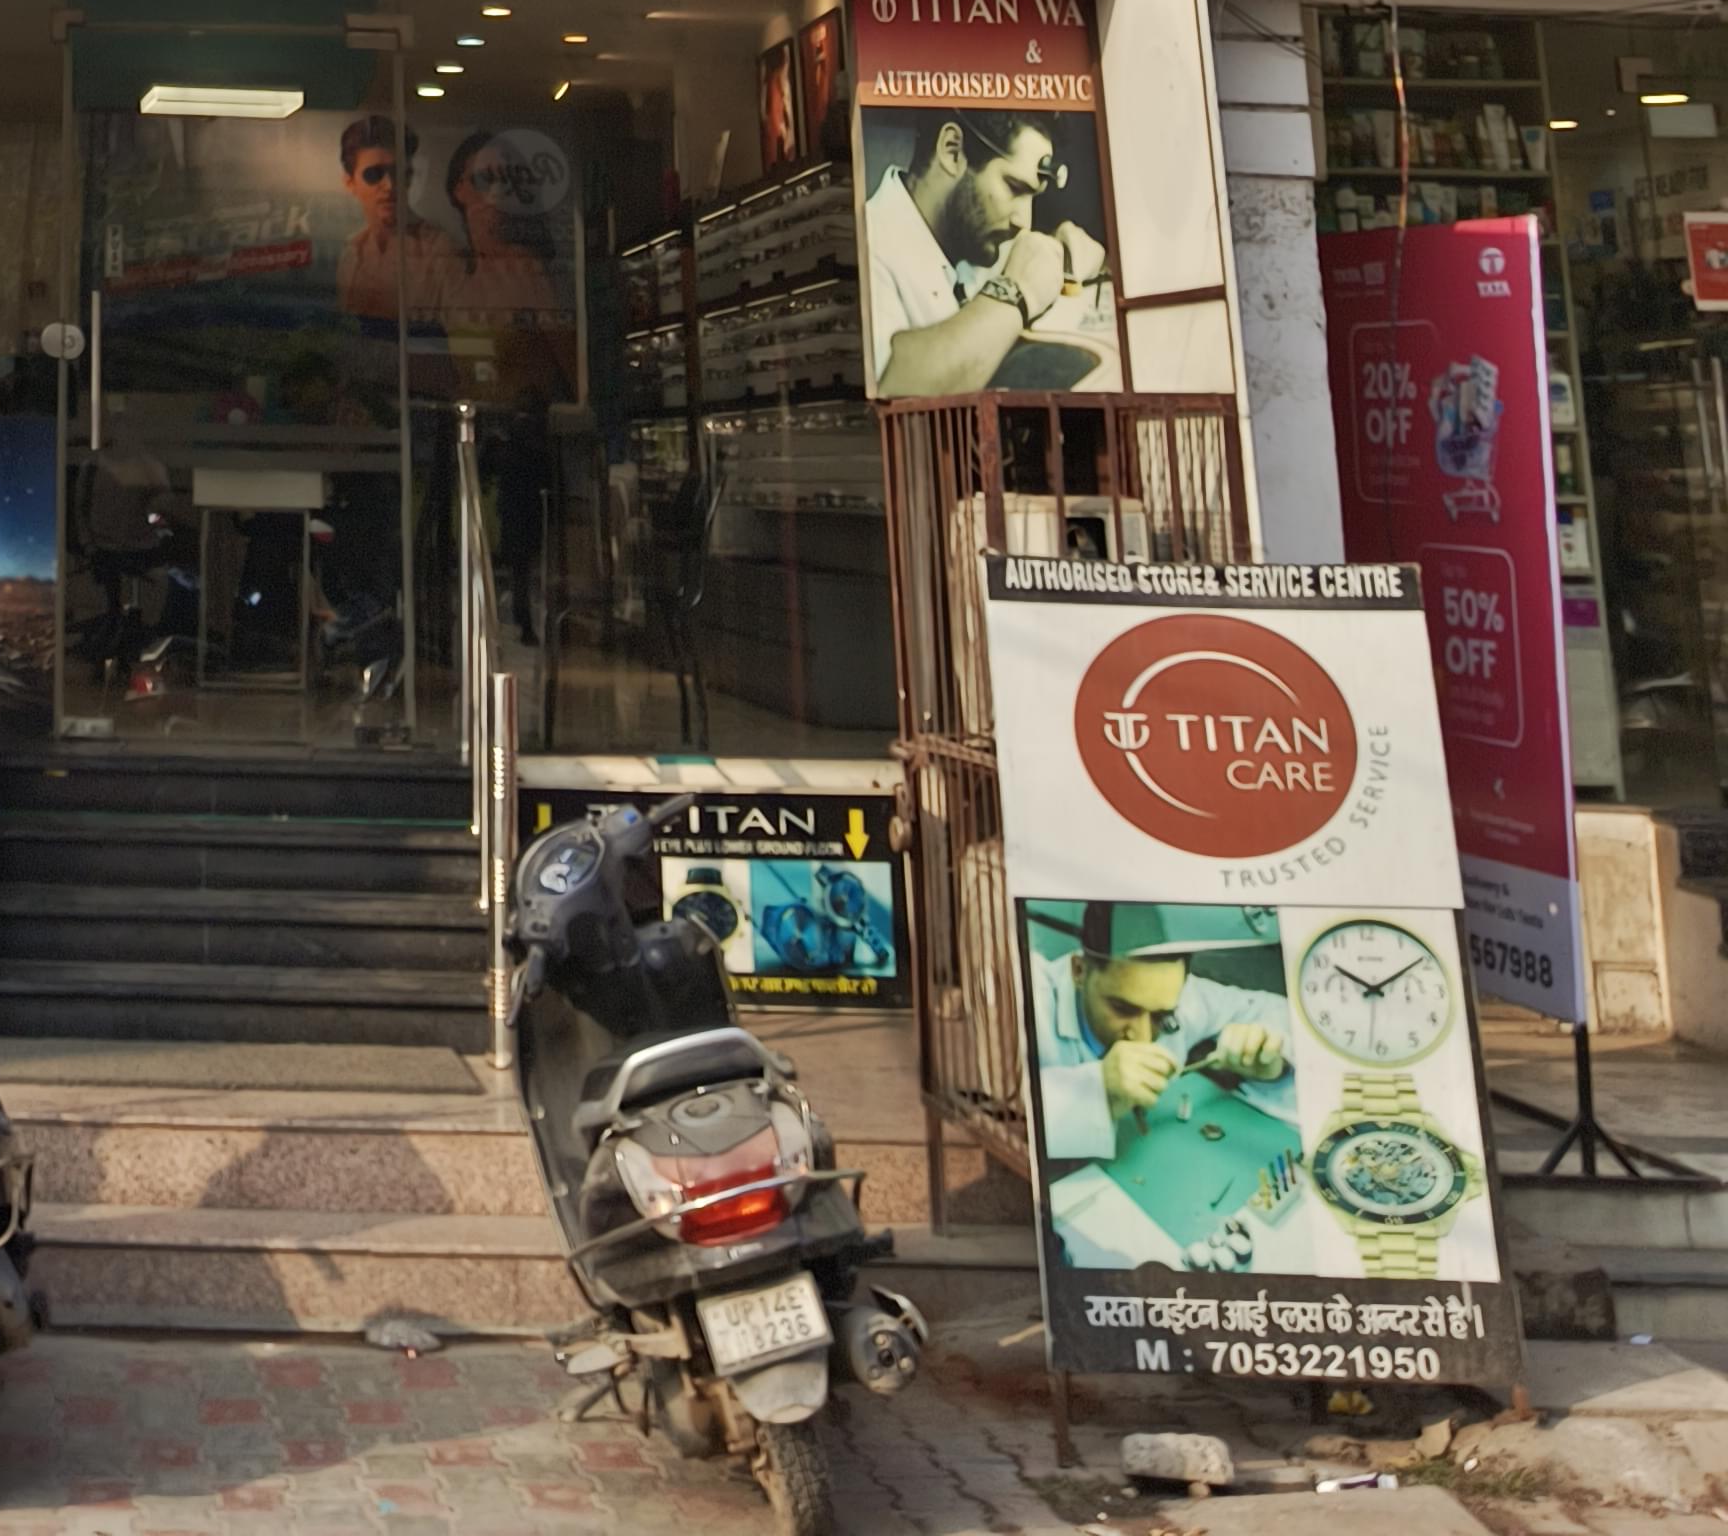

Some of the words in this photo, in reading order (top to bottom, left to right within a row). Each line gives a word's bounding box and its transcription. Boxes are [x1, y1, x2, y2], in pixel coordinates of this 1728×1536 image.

[1025, 40, 1042, 64] &
[873, 70, 1011, 99] AUTHORISED
[1005, 560, 1131, 594] AUTHORISED
[1225, 564, 1316, 599] SERVICE
[1319, 565, 1404, 598] CENTRE
[1443, 586, 1504, 633] 50%
[1445, 635, 1498, 679] OFF
[1165, 713, 1330, 755] TITAN
[1226, 759, 1335, 793] CARE
[663, 803, 815, 836] ITAN
[1220, 835, 1348, 890] TRUSTED
[1349, 724, 1390, 830] SERVICE
[1135, 1338, 1170, 1372] M
[1205, 1341, 1440, 1381] 7053221950
